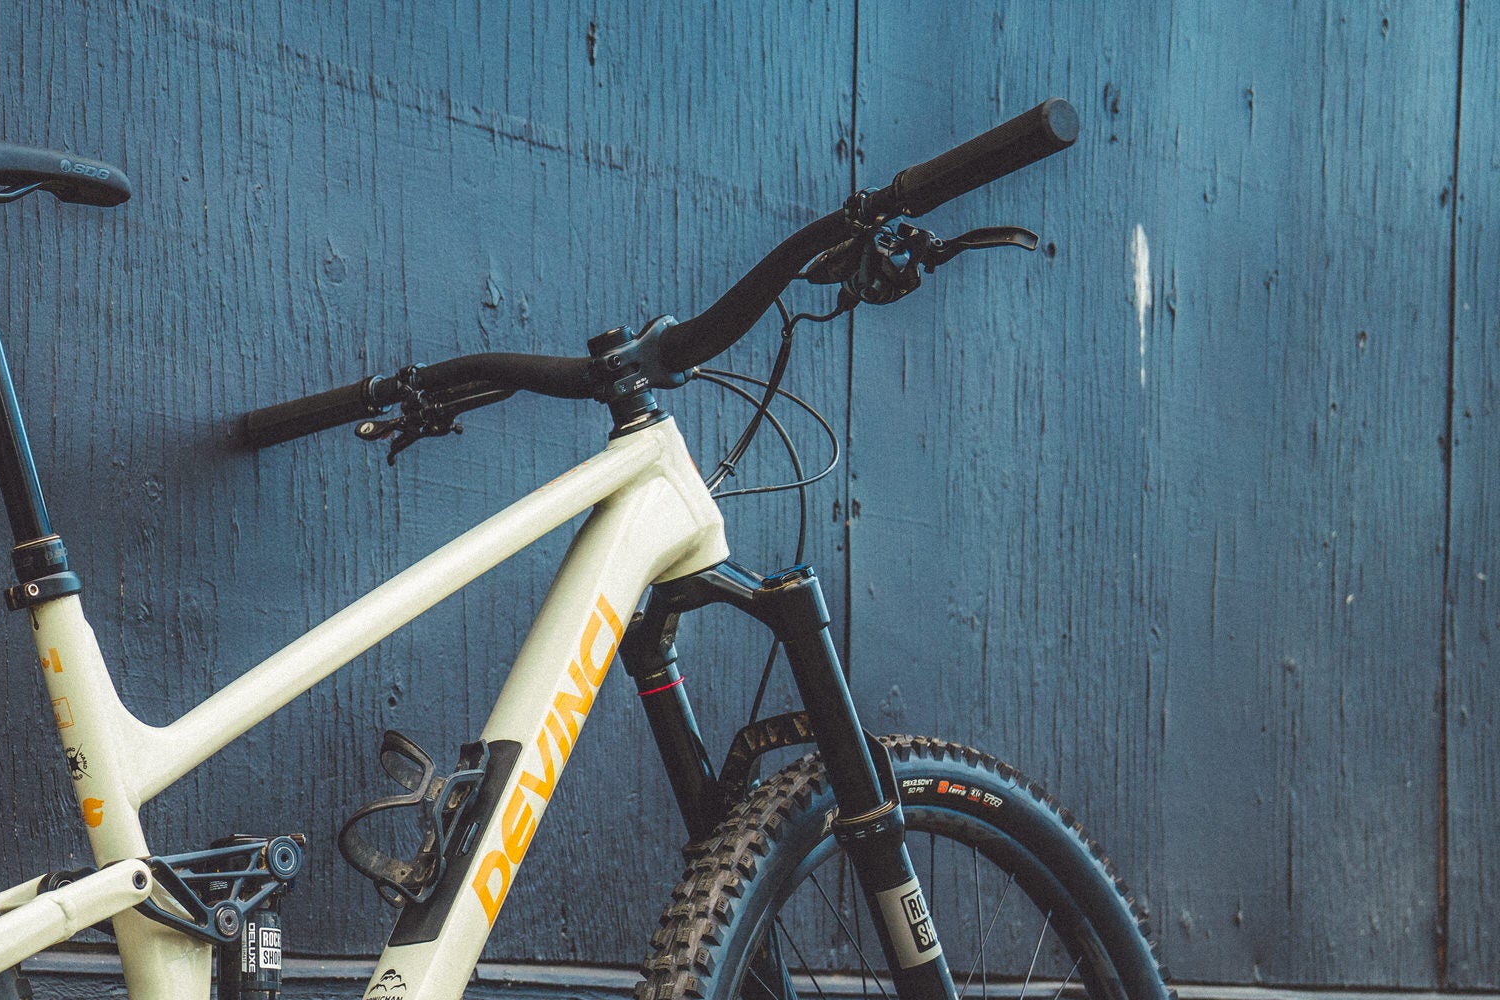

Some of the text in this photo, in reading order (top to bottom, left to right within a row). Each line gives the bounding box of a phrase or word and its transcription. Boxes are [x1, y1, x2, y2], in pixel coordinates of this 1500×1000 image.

[72, 163, 110, 180] SDG
[472, 593, 624, 930] DEVINCI
[248, 922, 256, 973] DELUXE
